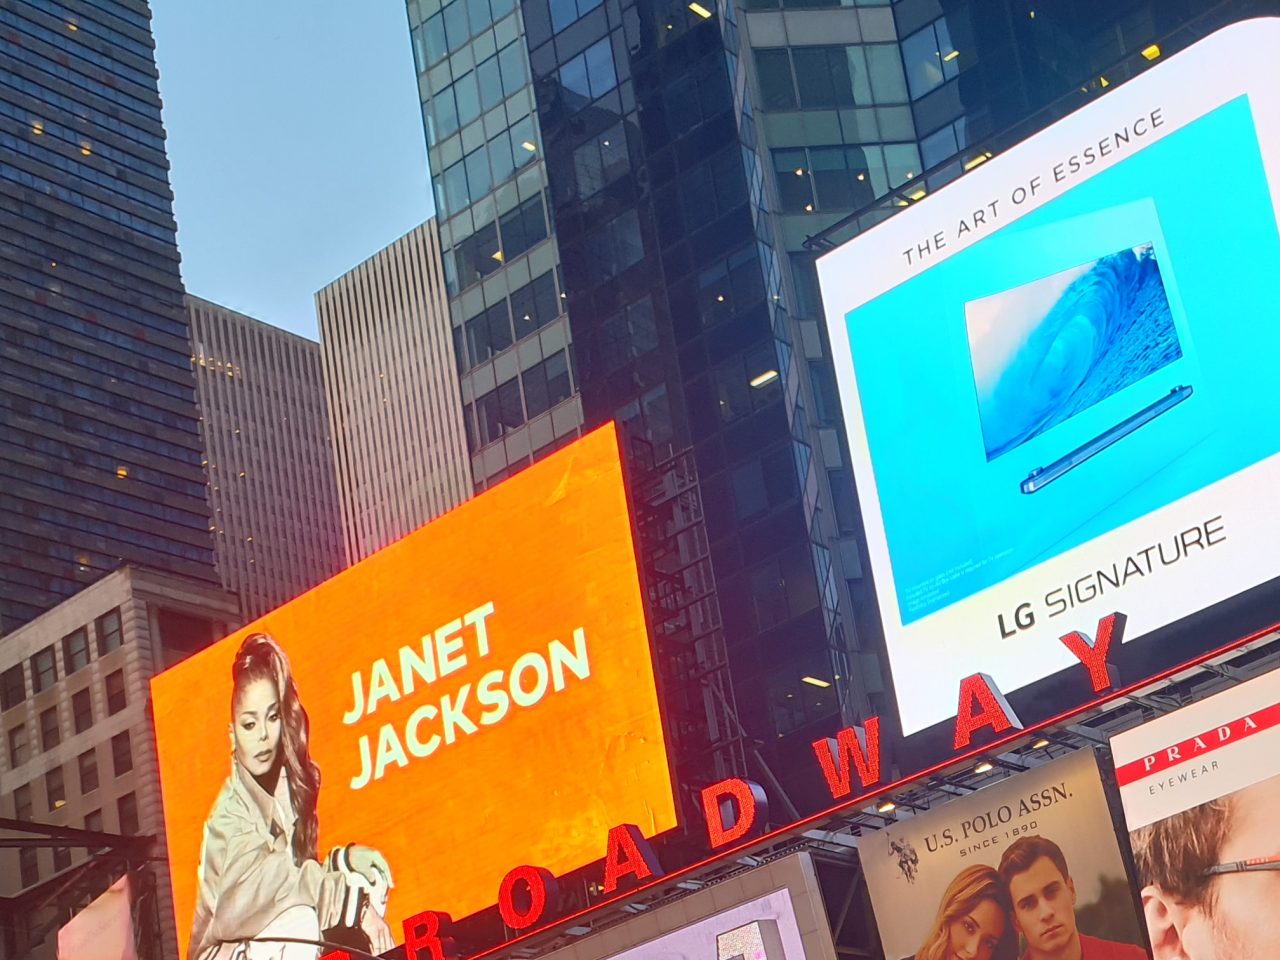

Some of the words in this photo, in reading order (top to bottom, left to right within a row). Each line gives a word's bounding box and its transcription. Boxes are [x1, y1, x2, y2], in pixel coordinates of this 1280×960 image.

[902, 231, 947, 266] THE
[957, 200, 1000, 239] ART
[1011, 176, 1042, 206] OF
[1052, 107, 1165, 184] ESSENCE
[997, 602, 1036, 640] LG
[1044, 514, 1229, 618] SIGNATURE
[342, 600, 496, 726] JANET
[349, 626, 592, 791] JACKSON
[1143, 716, 1258, 772] PRADA
[1148, 760, 1220, 796] EYEWEAR
[924, 828, 959, 854] U.S.
[961, 805, 1013, 840] POLO
[1017, 782, 1074, 818] ASSN.
[959, 835, 1000, 858] SINCE
[1005, 820, 1039, 840] 1890
